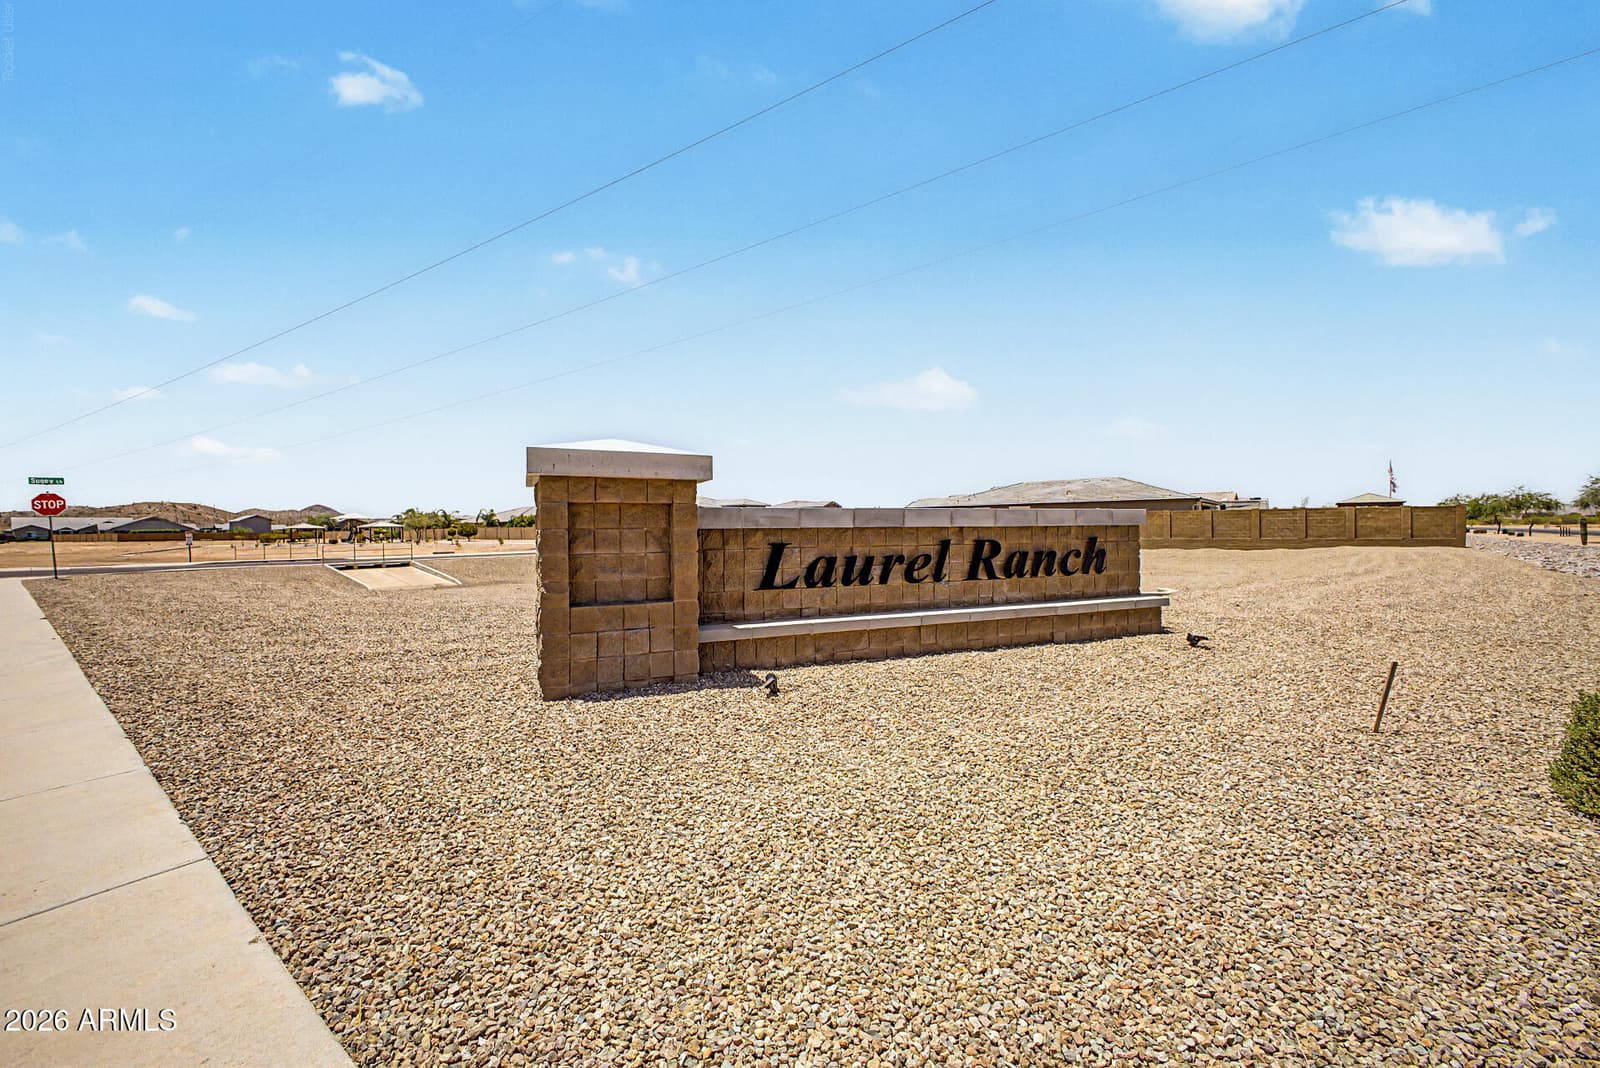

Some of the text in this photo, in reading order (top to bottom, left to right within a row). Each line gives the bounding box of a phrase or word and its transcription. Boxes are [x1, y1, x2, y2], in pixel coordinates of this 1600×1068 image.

[33, 499, 64, 510] STOP
[754, 536, 1107, 591] Laurel Ranch
